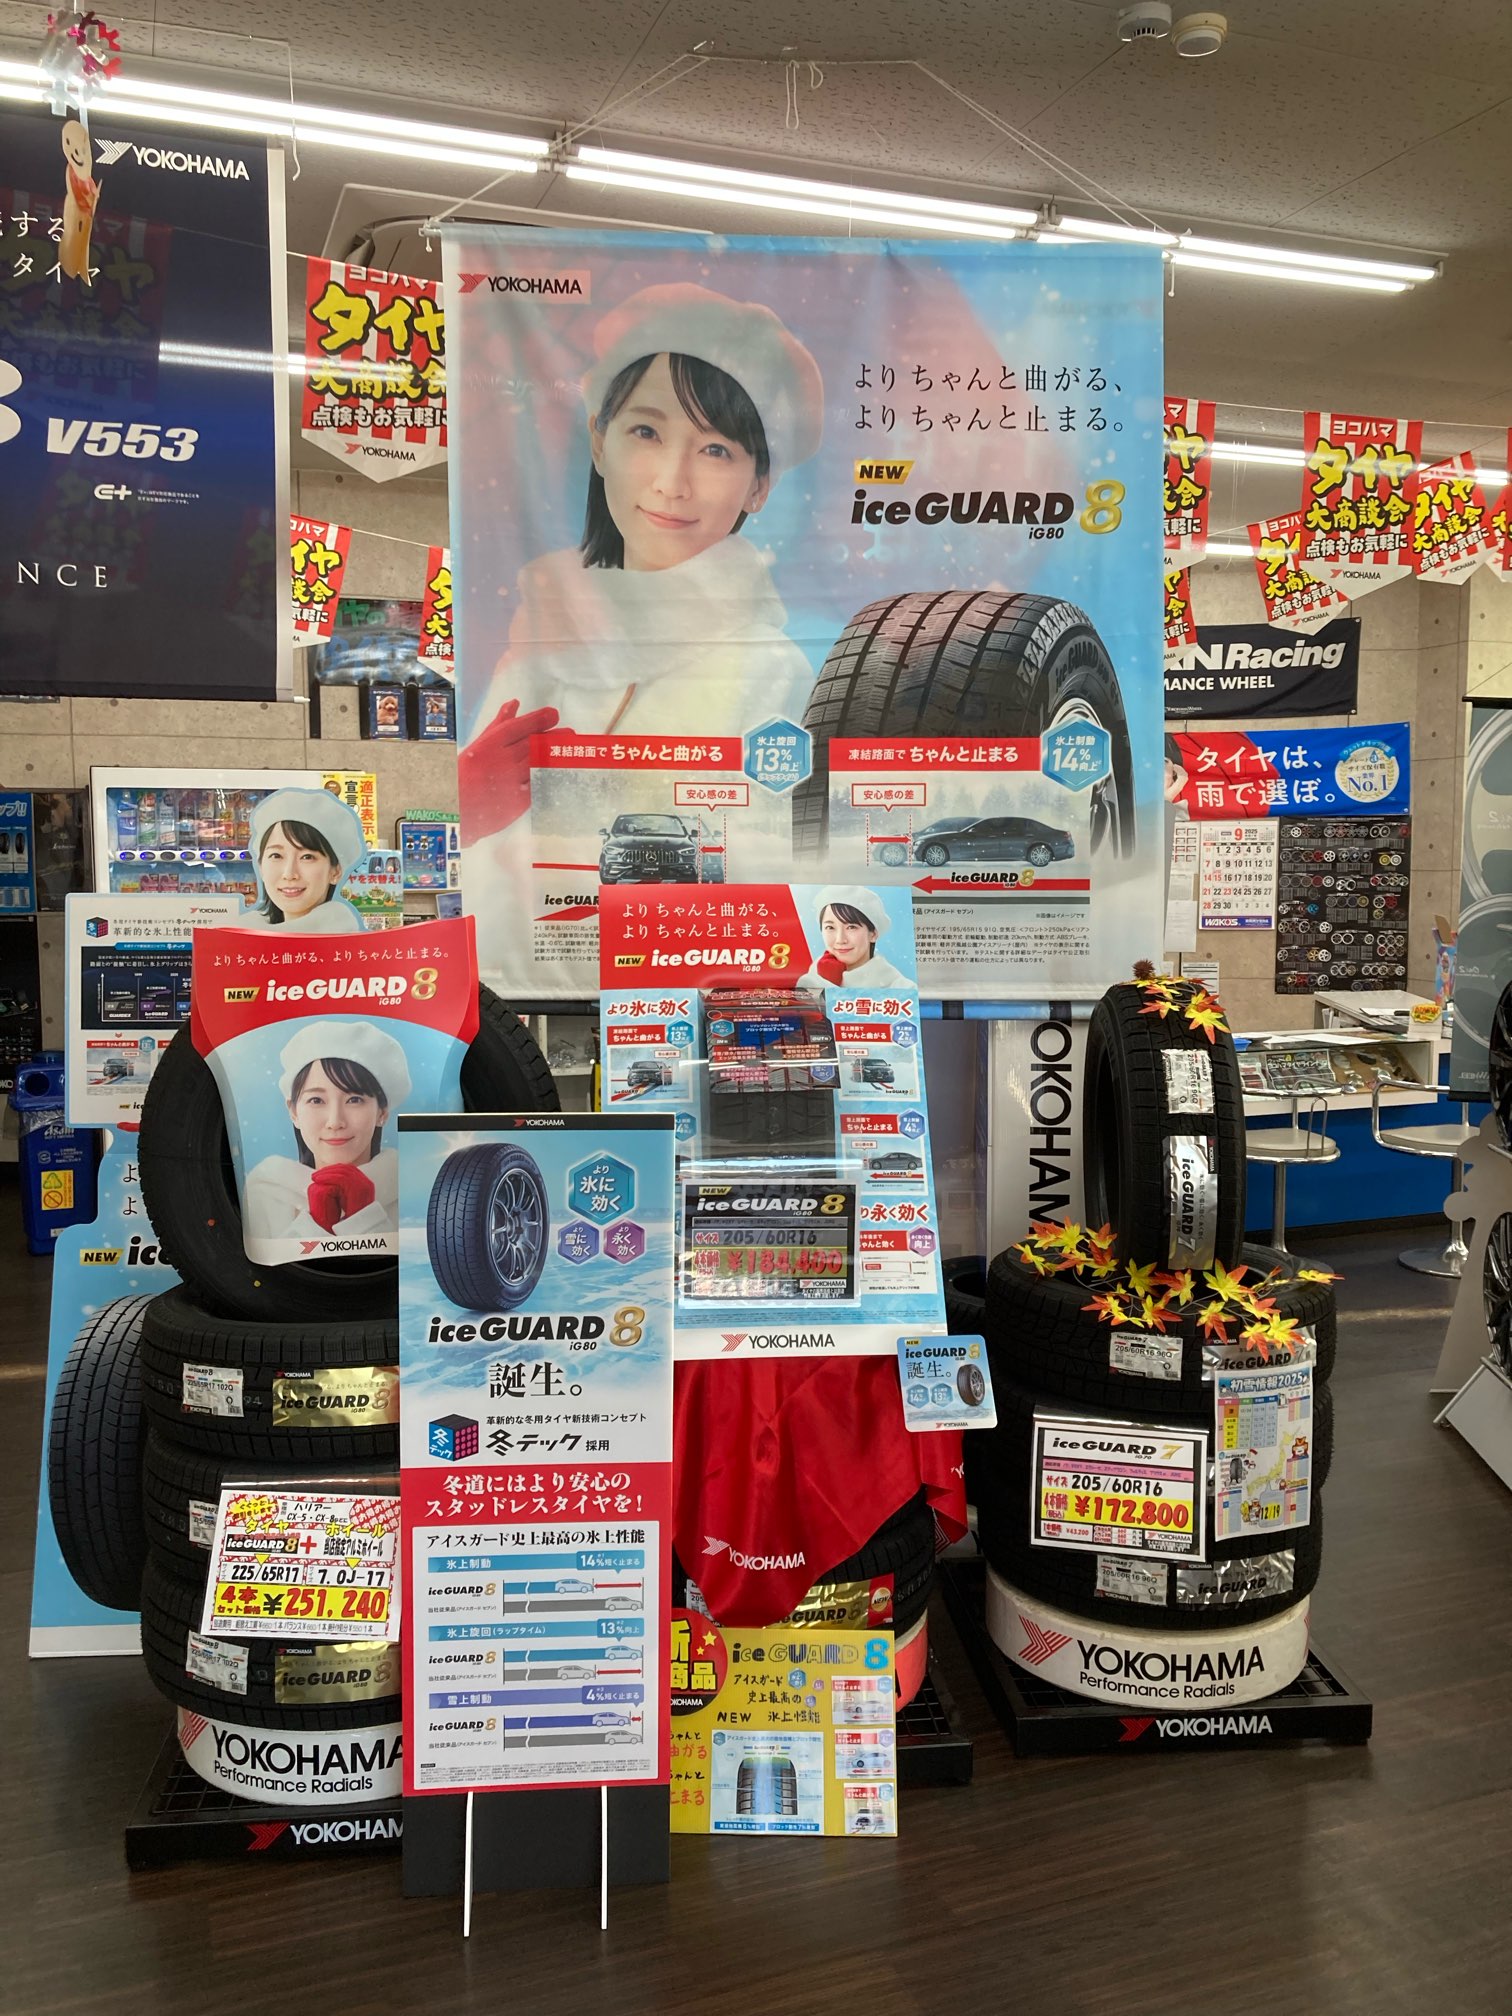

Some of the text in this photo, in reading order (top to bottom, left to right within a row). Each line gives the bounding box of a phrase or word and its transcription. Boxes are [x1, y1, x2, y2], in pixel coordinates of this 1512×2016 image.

[132, 145, 250, 180] YOKOHAMA
[487, 274, 582, 295] YOKOHAMA
[311, 281, 445, 356] タイヤ
[1333, 420, 1394, 438] ヨコハマ
[47, 417, 199, 462] V553
[361, 446, 416, 462] YOKOHAMA
[859, 464, 905, 480] NEW
[1305, 437, 1416, 497] タイヤ
[851, 479, 1126, 534] iceGUARD 8
[1304, 494, 1414, 534] 大商談会
[1029, 527, 1064, 540] iG80
[1305, 532, 1408, 560] 点検もお気軽に
[1342, 570, 1382, 581] YOKOHAMA
[1300, 611, 1330, 625] YOKOHAMA
[1224, 640, 1346, 670] Racing
[1219, 676, 1275, 690] WHEEL
[757, 736, 797, 747] 氷上旋回
[1055, 735, 1096, 747] 氷上制動
[611, 744, 723, 762] ちゃんと曲がる
[909, 745, 1019, 763] ちゃんと止まる
[1195, 746, 1324, 774] タイヤは、
[1347, 774, 1388, 792] No.1
[686, 789, 738, 801] 安心感の差
[863, 789, 915, 801] 安心感の差
[1195, 778, 1336, 808] 雨で選ぼ。
[359, 780, 374, 836] 適正表示
[1234, 828, 1243, 841] 9
[951, 872, 1019, 884] iceGUARD
[617, 943, 791, 969] NEW iceGUARD 8
[228, 967, 439, 1002] NEW iceGUARD 8
[379, 997, 402, 1006] iG80
[607, 1000, 689, 1016] より氷に効く
[833, 999, 913, 1016] より雪に効く
[1029, 1020, 1073, 1234] OKOHAM
[593, 1164, 609, 1174] より
[579, 1175, 615, 1193] 氷に
[590, 1194, 621, 1212] 効く
[697, 1194, 846, 1215] iceGUARD 8
[1182, 1158, 1195, 1235] iceGUARD
[320, 1239, 388, 1253] YOKOHAMA
[564, 1232, 587, 1244] 雪に
[611, 1232, 632, 1244] 永く
[695, 1230, 817, 1246] サイズ 205/60R16
[914, 1241, 931, 1249] 向上
[84, 1252, 117, 1262] NEW
[571, 1245, 591, 1257] 効く
[617, 1245, 637, 1257] 効く
[727, 1249, 843, 1275] ¥184,400
[428, 1316, 605, 1343] iceGUARD
[609, 1306, 646, 1347] 8
[569, 1341, 597, 1351] iG80
[749, 1333, 836, 1349] YOKOHAMA
[905, 1347, 967, 1358] iceGUARD
[1223, 1351, 1292, 1370] iceGUARD
[906, 1361, 952, 1380] 誕生。
[488, 1361, 583, 1400] 誕生。
[1230, 1372, 1304, 1394] 初雪情報2025
[280, 1394, 370, 1409] iceGUARD
[486, 1413, 648, 1426] 革新的な冬用タイヤ新技術コンセプト
[485, 1428, 610, 1457] 冬テック 採用
[1052, 1437, 1185, 1460] iceGUARD 7
[443, 1471, 631, 1496] 冬道にはより安心の
[1046, 1474, 1163, 1497] サイズ 205/60R16
[294, 1503, 332, 1512] ハリアー
[424, 1494, 643, 1518] スタッドレスタイヤを!
[1074, 1495, 1190, 1529] ¥172,800
[1260, 1504, 1281, 1521] 12/19
[245, 1519, 386, 1538] タイヤ ホイール
[1157, 1533, 1192, 1542] YOKOHAMA
[226, 1537, 299, 1553] iceGUARD 8
[426, 1529, 645, 1548] アイスガード史上最高の氷上性能
[446, 1558, 492, 1570] 氷上制動
[729, 1547, 806, 1571] YOKOHAMA
[231, 1565, 300, 1583] 225/65R17
[318, 1568, 386, 1586] 7.0J-17
[428, 1585, 484, 1596] iceGUARD
[1198, 1578, 1267, 1595] iceGUARD
[221, 1586, 387, 1620] 4本 ¥251,240
[428, 1653, 484, 1664] iceGUARD
[864, 1638, 890, 1670] 8
[1077, 1640, 1265, 1683] YOKOHAMA
[283, 1669, 371, 1686] iceGUARD
[733, 1674, 784, 1686] アイスガード
[1080, 1671, 1235, 1699] Performance Radials
[447, 1693, 492, 1705] 雪上制動
[747, 1691, 802, 1705] 史上最高の
[429, 1720, 484, 1731] iceGUARD
[717, 1710, 821, 1724] NEW 氷上性能
[1156, 1715, 1273, 1738] YOKOHAMA
[212, 1724, 403, 1776] YOKOHAMA
[214, 1759, 373, 1793] Performance Radials
